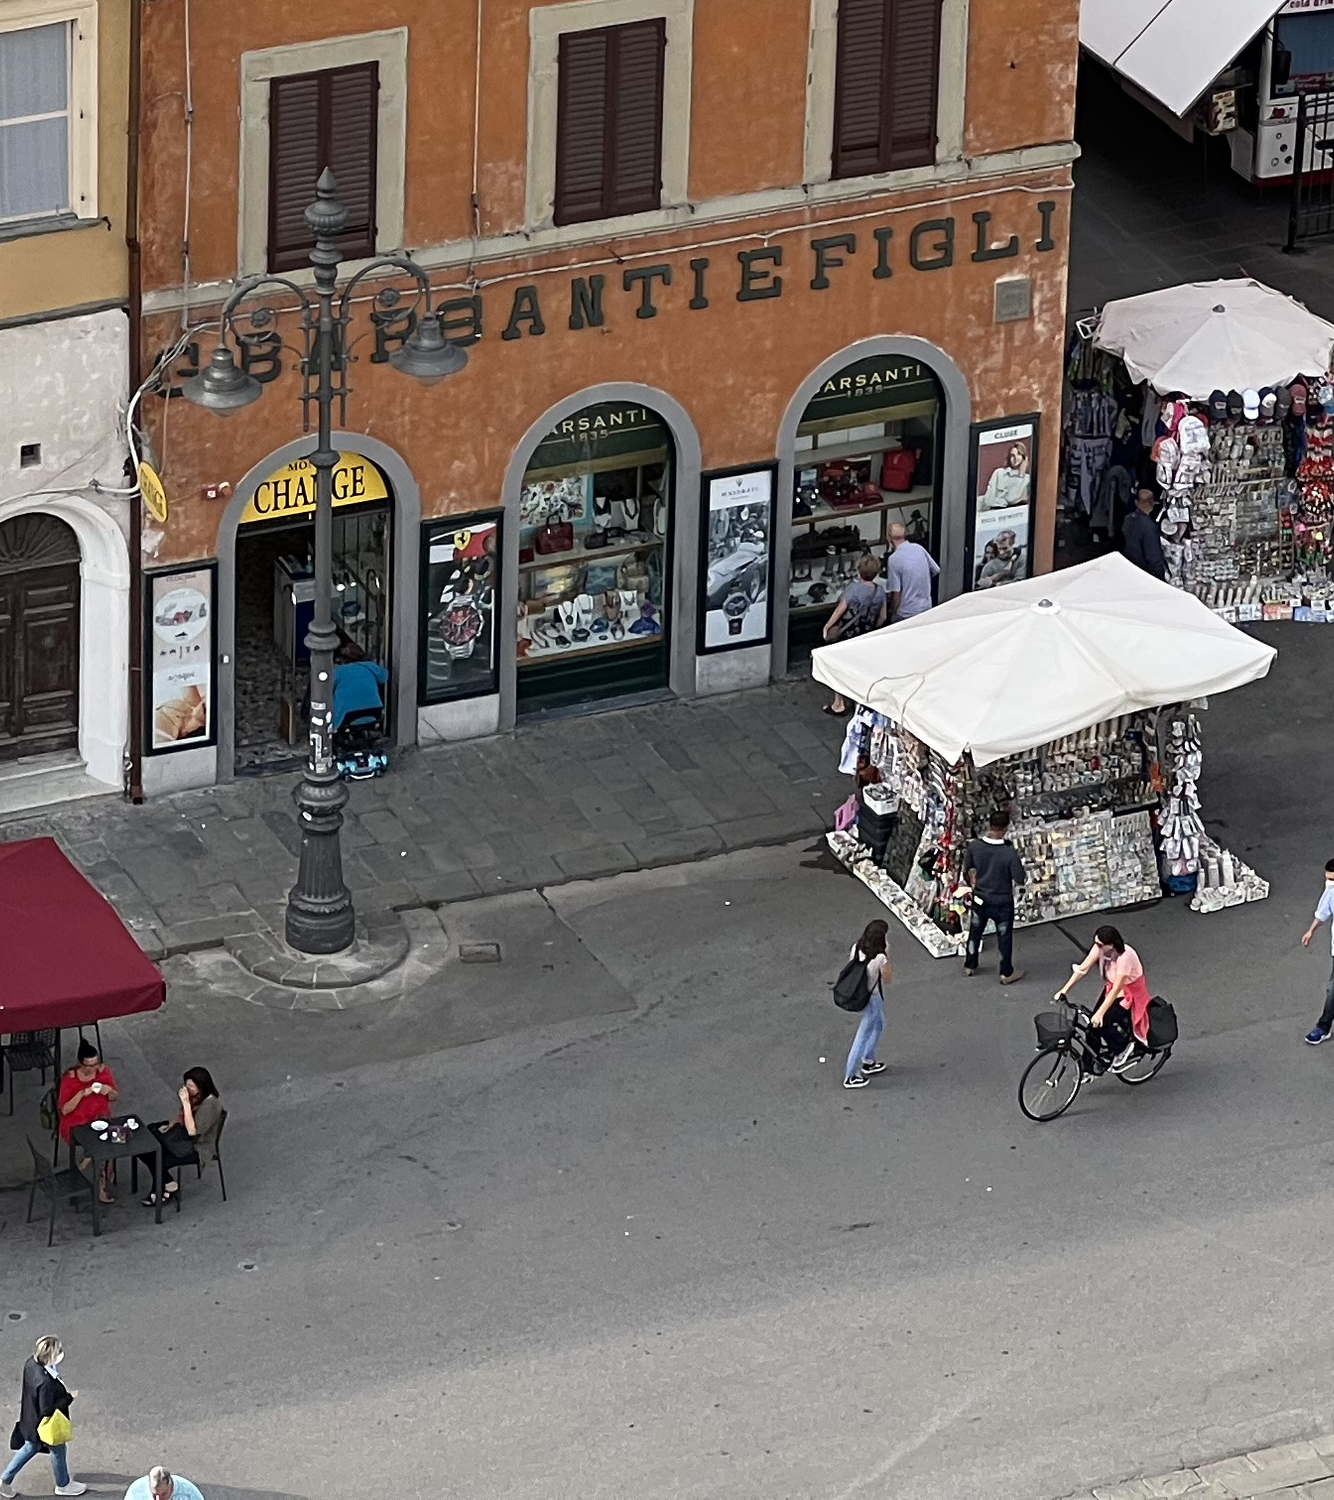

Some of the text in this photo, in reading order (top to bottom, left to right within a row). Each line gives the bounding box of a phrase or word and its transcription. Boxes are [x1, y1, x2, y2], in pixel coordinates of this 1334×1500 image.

[735, 244, 783, 302] E
[809, 199, 1057, 291] FIGLI
[817, 364, 921, 394] ARSANTI
